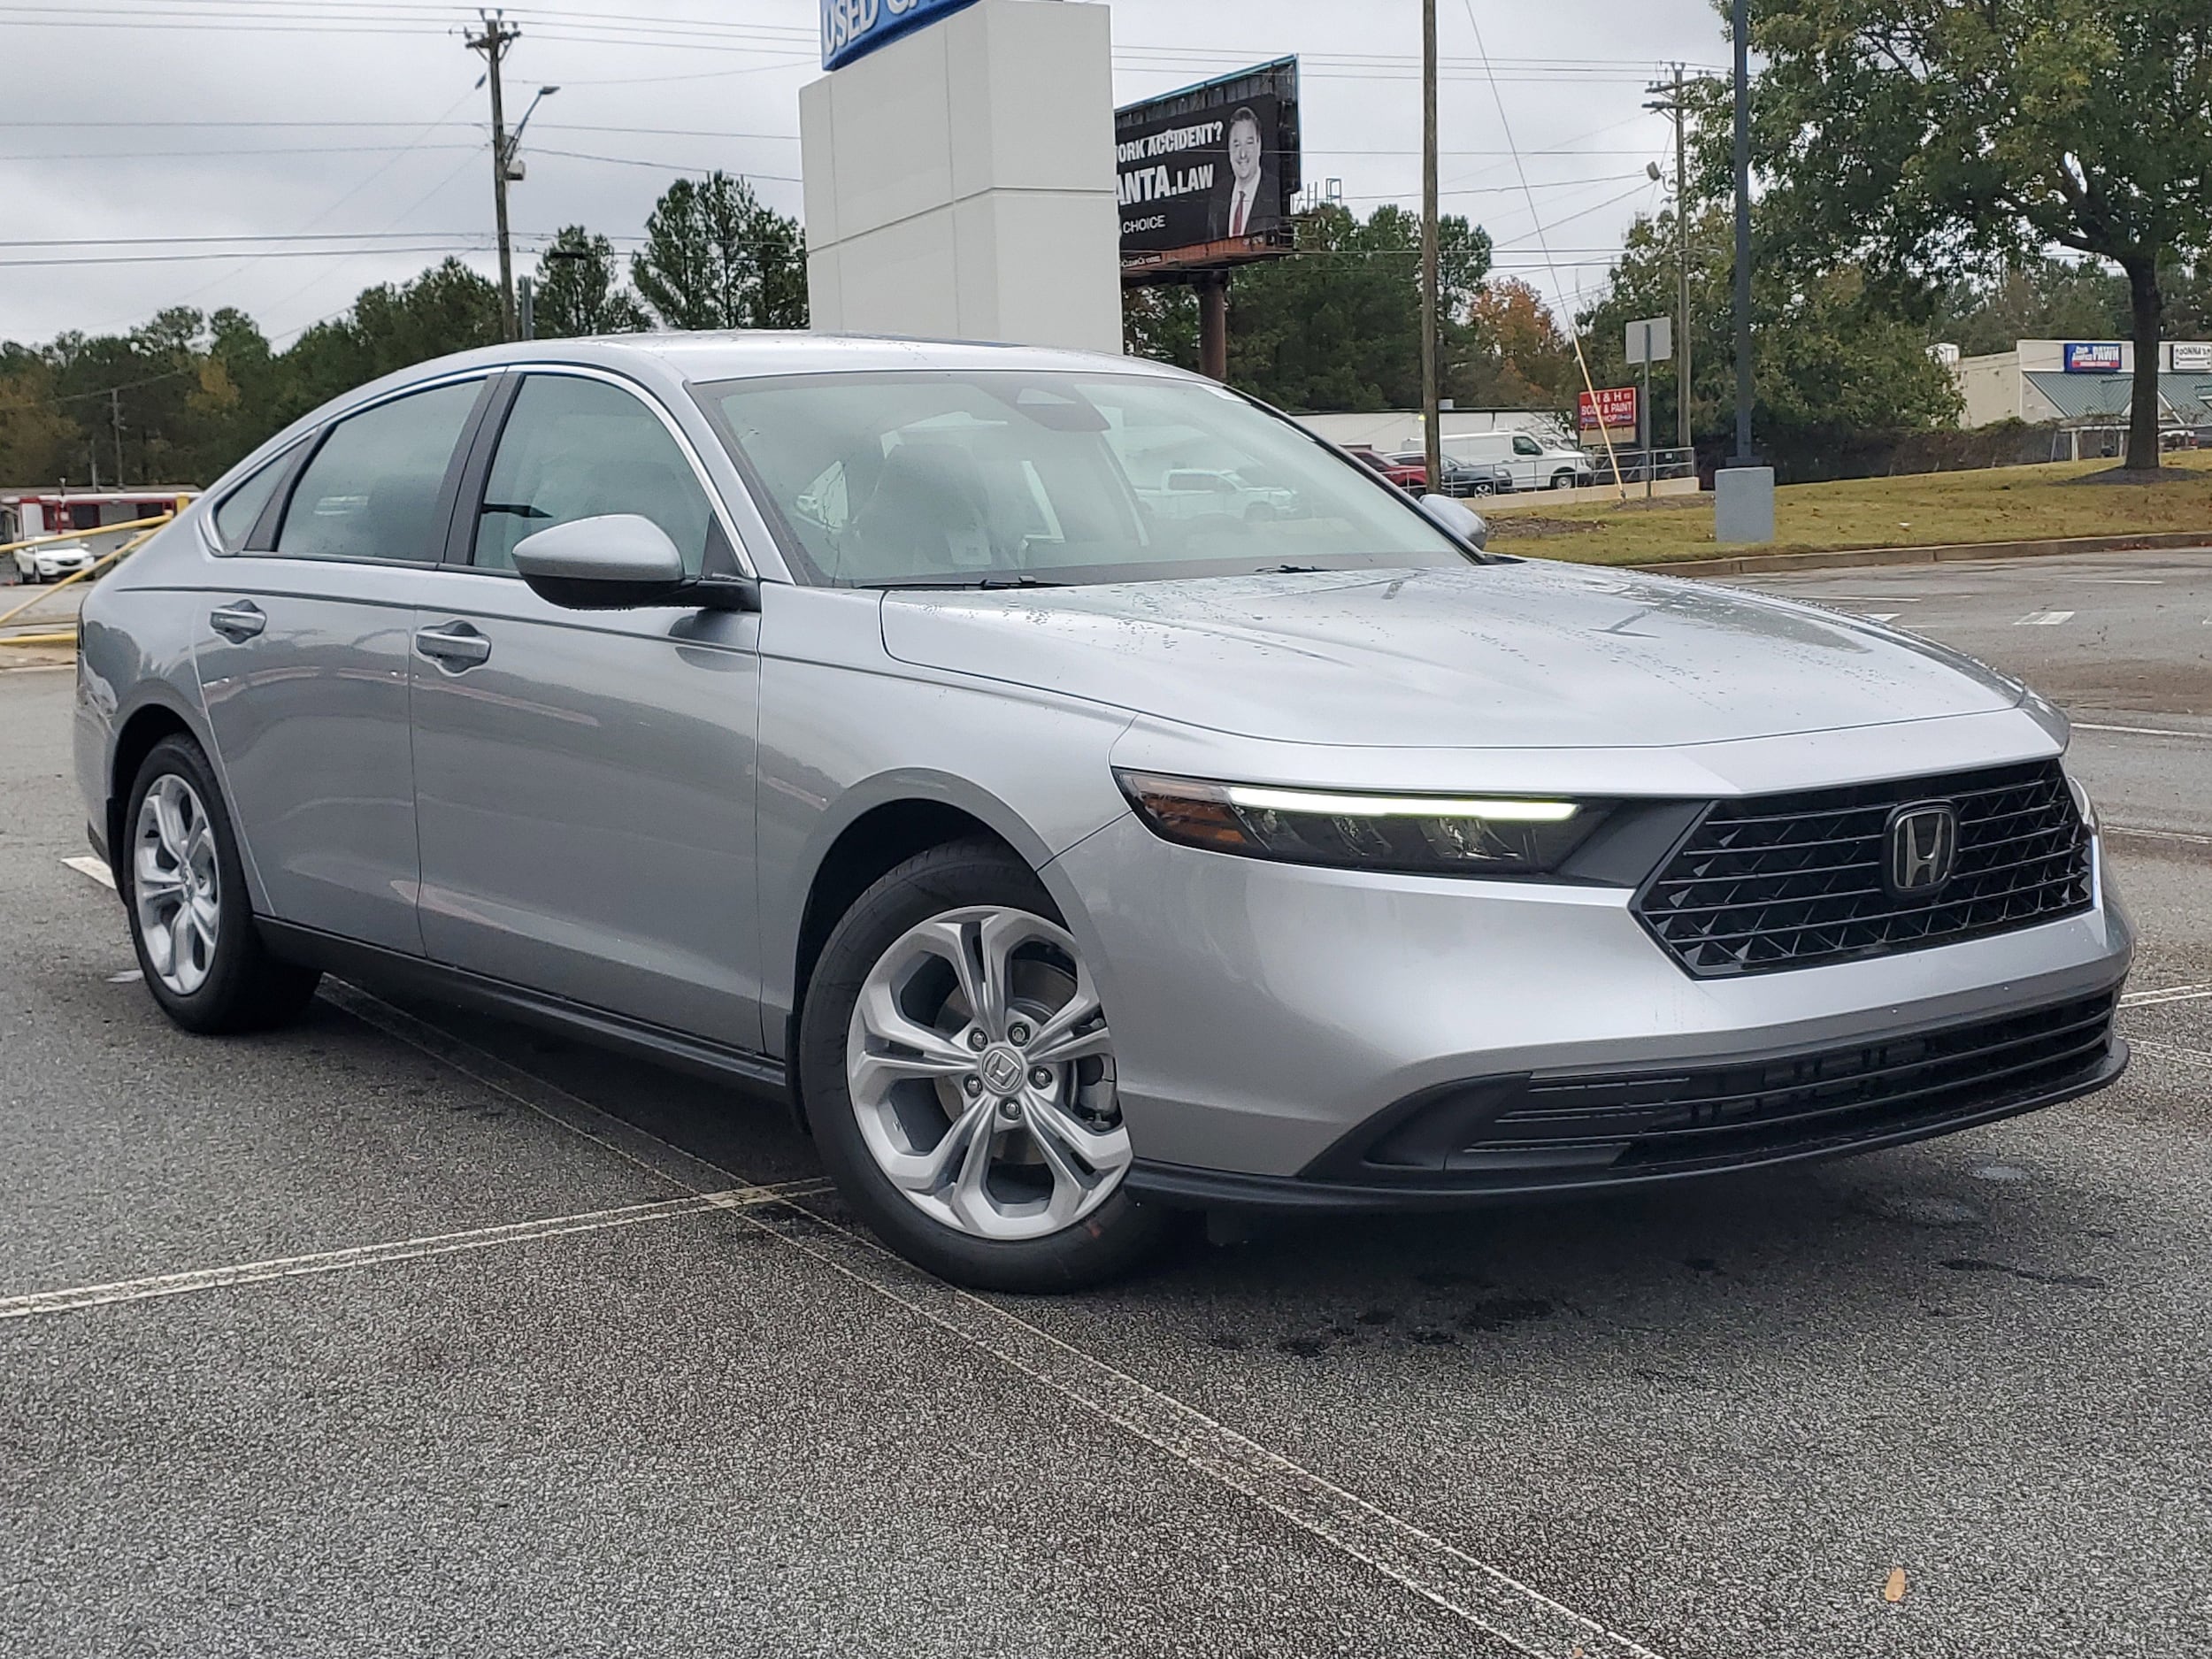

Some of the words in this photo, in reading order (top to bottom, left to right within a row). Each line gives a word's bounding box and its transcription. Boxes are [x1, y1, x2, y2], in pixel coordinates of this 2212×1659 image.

[824, 0, 879, 55] USED
[1117, 138, 1146, 163] ORK
[1147, 121, 1224, 157] ACCIDENT?
[1123, 215, 1165, 234] CHOICE
[1614, 391, 1622, 402] H
[1611, 402, 1632, 413] PAINT
